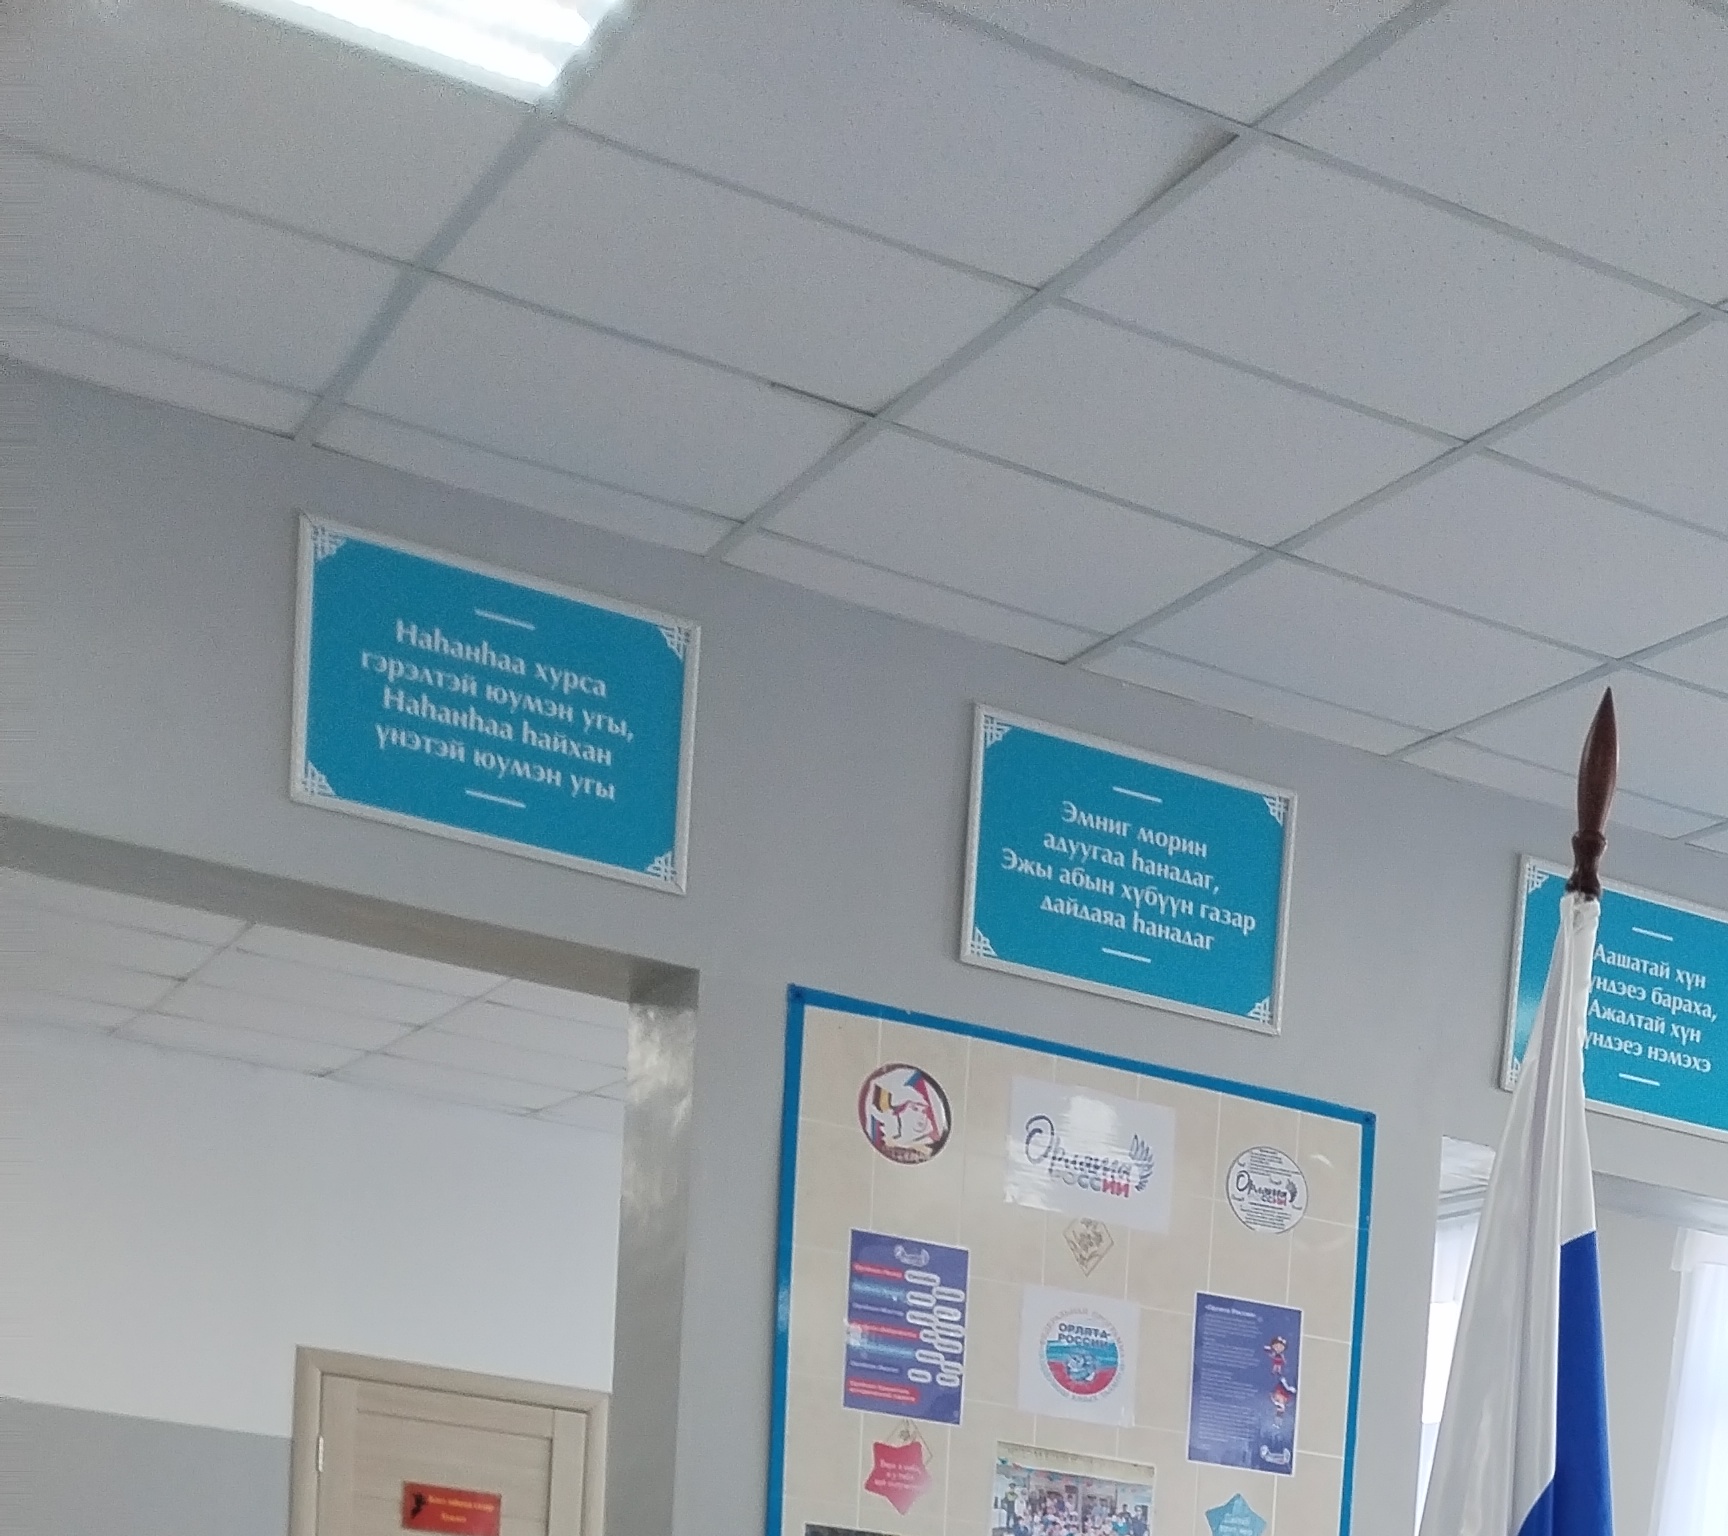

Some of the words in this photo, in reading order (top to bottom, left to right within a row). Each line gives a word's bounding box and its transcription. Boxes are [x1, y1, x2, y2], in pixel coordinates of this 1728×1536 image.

[361, 651, 477, 697] гэрэлтэй
[535, 662, 606, 698] хурса
[570, 774, 615, 800] угы
[1061, 800, 1131, 837] Эмниг
[1137, 827, 1207, 857] морин
[1043, 832, 1125, 868] адуугаа
[1001, 847, 1052, 880] Эжы
[1059, 867, 1115, 896] абын
[1200, 904, 1256, 936] газар
[1040, 895, 1125, 930] дайдаяа
[1593, 943, 1670, 979] Аашатай
[1587, 999, 1666, 1034] Ажалтай
[1651, 987, 1717, 1022] бараха,
[1647, 1046, 1711, 1073] нэмэхэ
